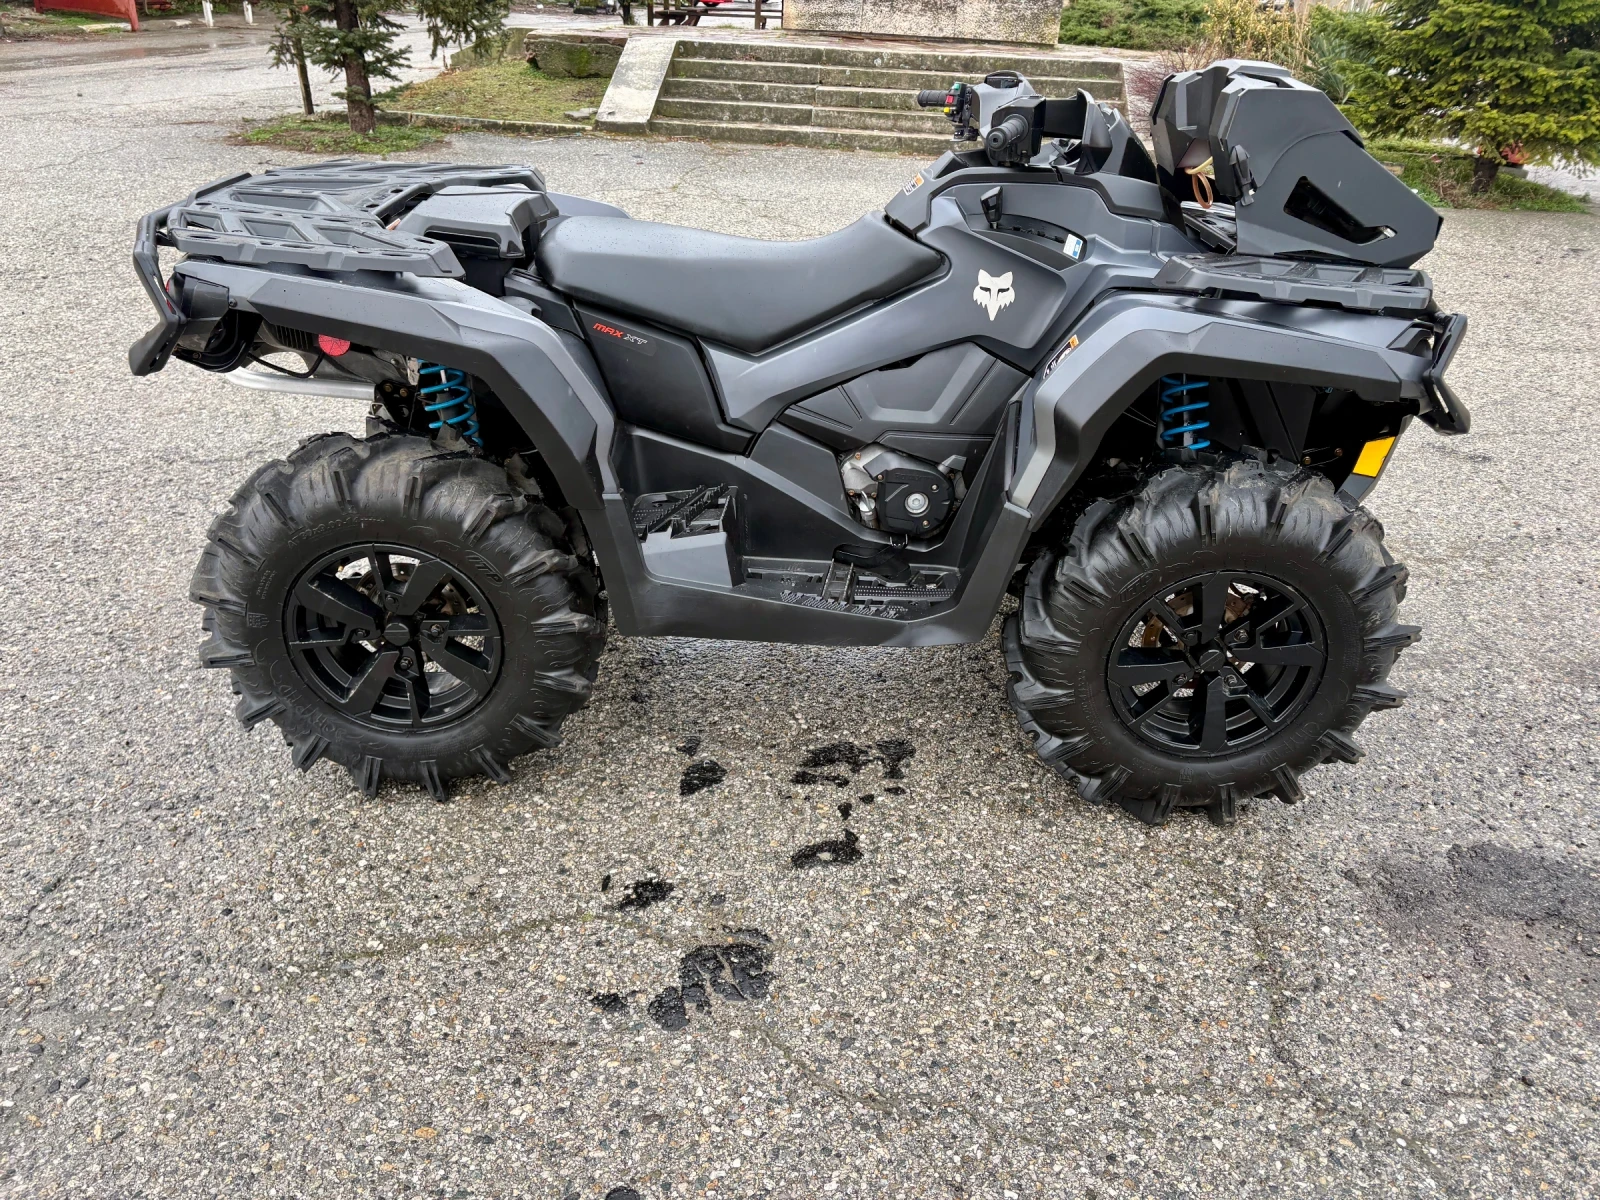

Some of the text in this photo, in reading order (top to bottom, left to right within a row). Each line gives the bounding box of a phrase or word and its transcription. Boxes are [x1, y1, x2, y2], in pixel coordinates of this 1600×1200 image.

[593, 322, 648, 345] MAX XT
[465, 555, 504, 584] ITP
